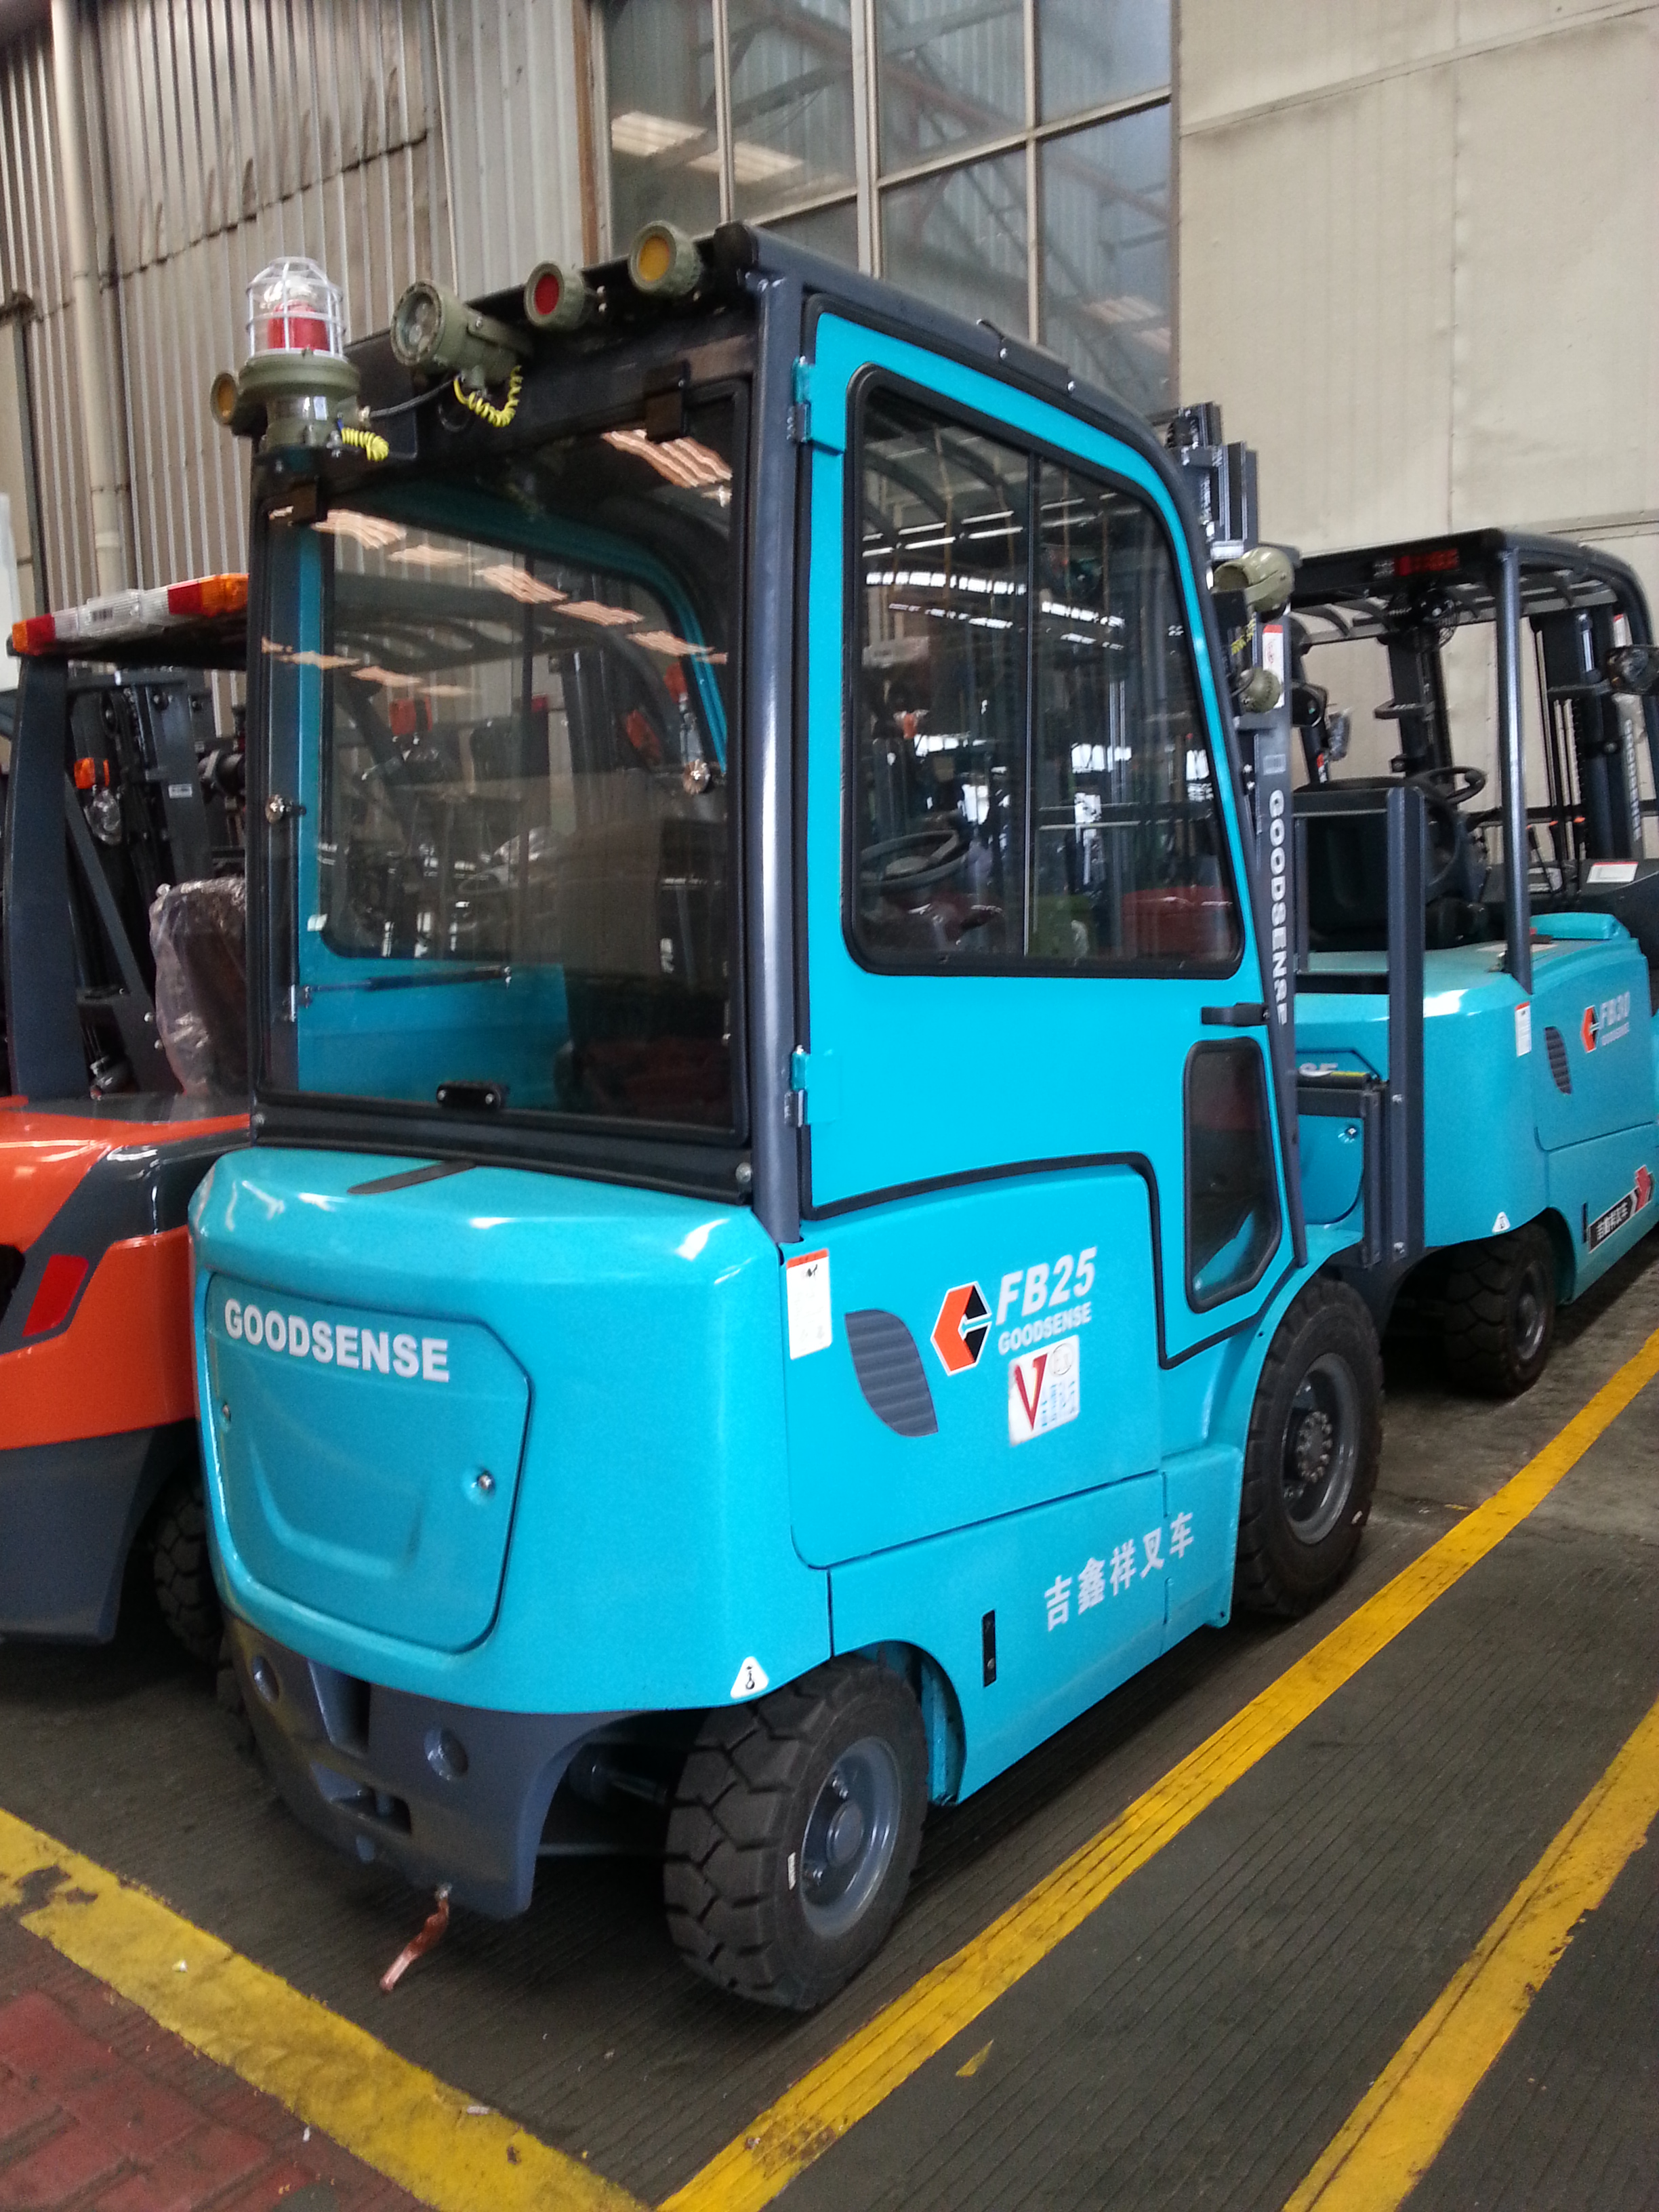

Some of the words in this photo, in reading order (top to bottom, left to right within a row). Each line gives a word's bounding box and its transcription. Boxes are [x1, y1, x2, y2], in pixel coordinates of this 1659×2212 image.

[996, 1246, 1097, 1326] FB25
[225, 1298, 449, 1382] GOODSENSE
[998, 1301, 1092, 1355] GOODSENSE
[1044, 1512, 1195, 1632] 吉鑫祥叉车
